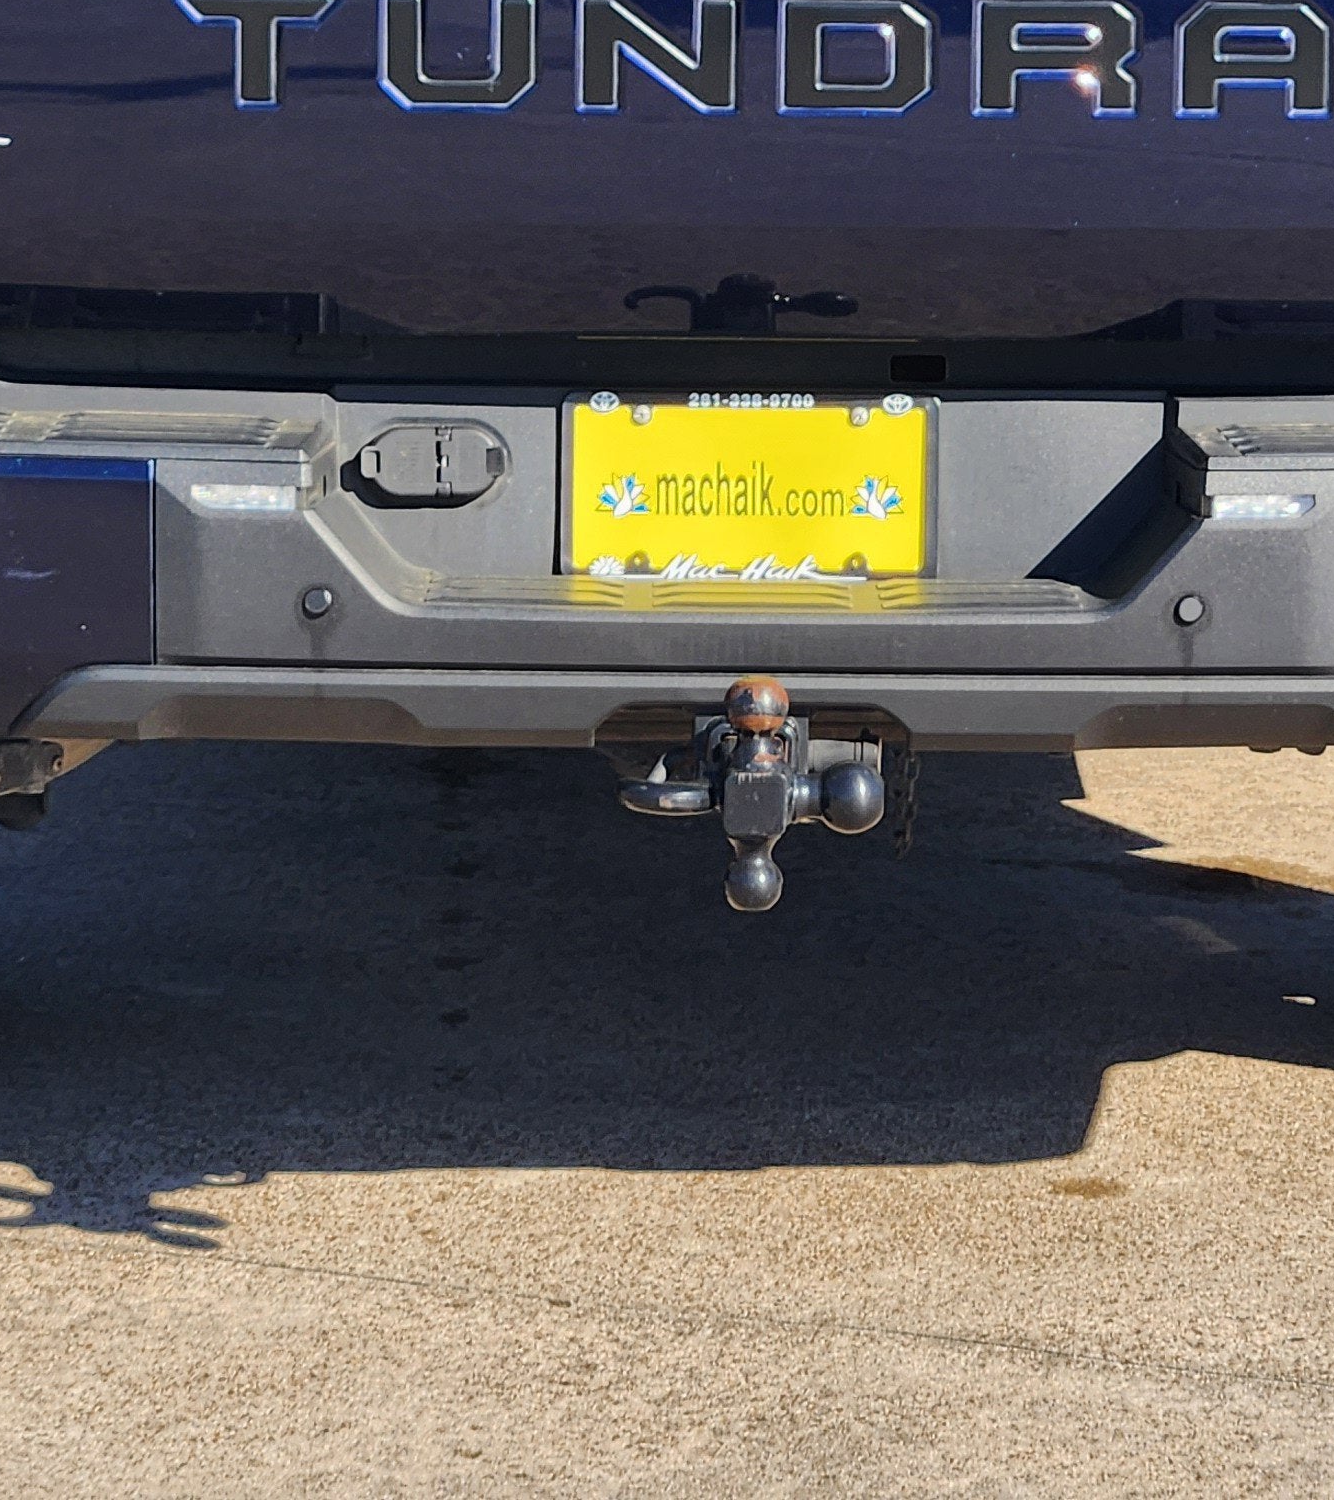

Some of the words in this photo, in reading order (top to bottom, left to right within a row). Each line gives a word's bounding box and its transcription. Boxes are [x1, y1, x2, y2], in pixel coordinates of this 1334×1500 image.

[655, 460, 845, 517] machaik.com
[651, 553, 730, 581] Mac
[737, 553, 837, 581] Haik
